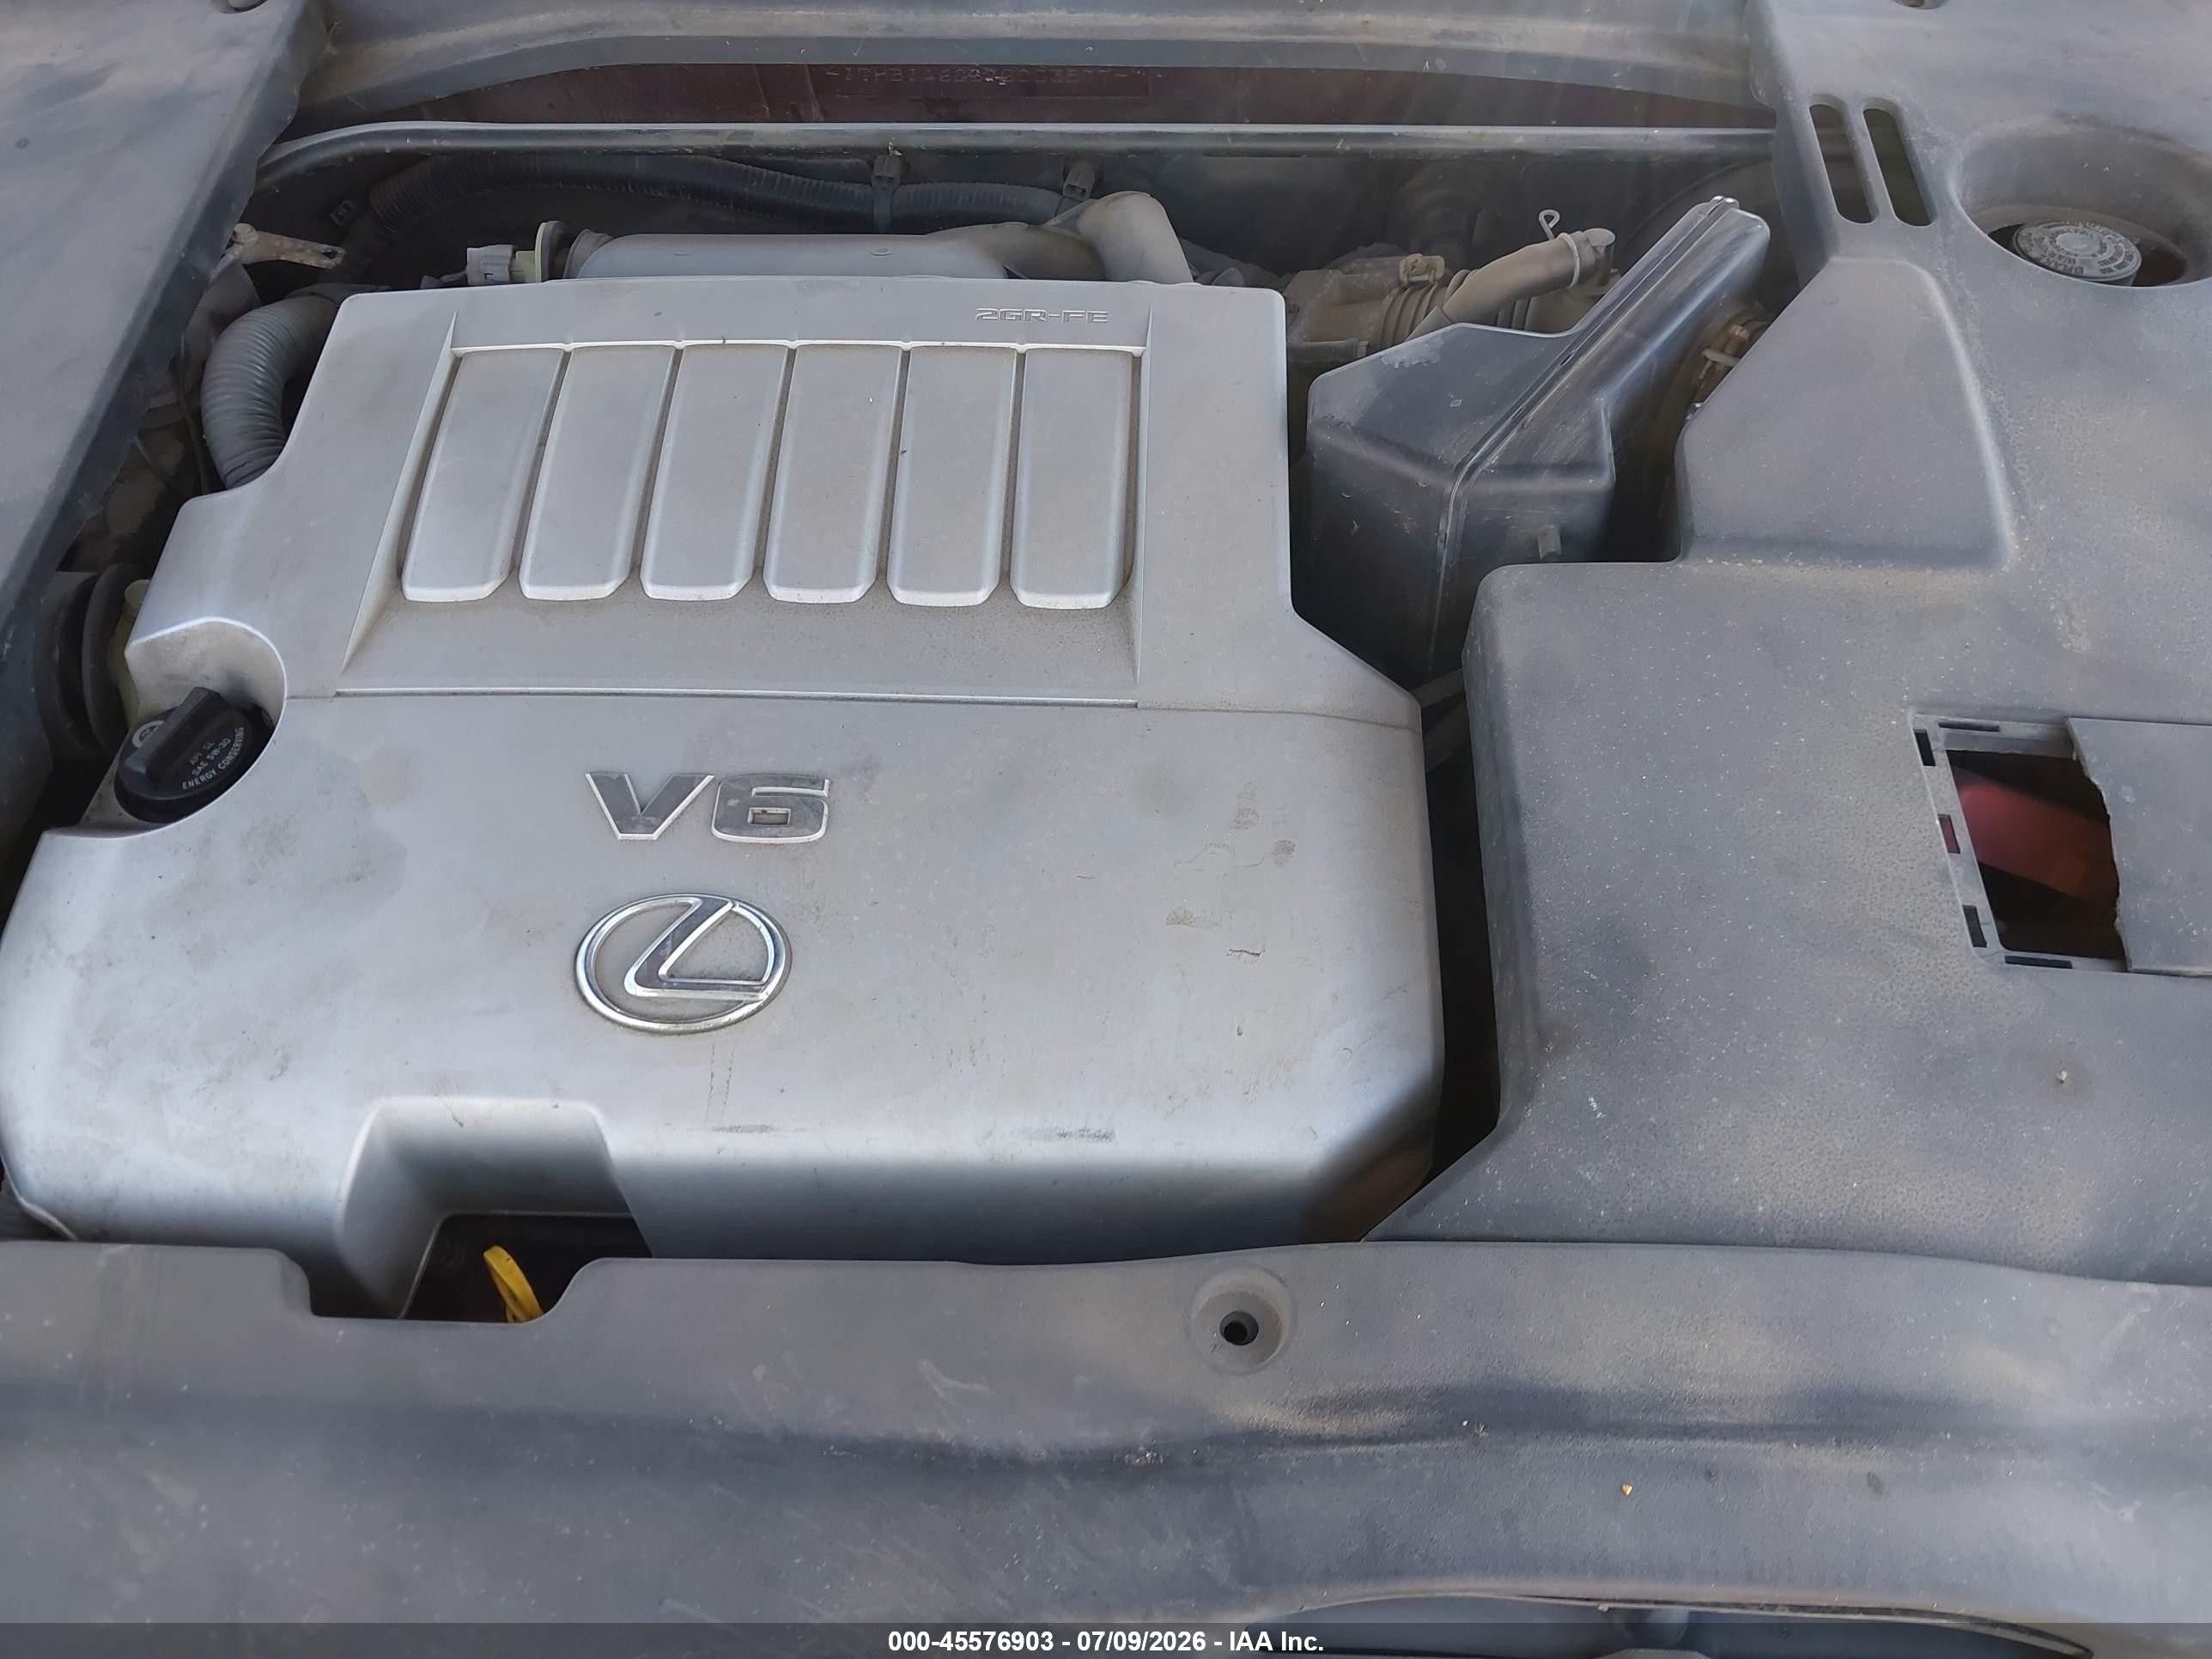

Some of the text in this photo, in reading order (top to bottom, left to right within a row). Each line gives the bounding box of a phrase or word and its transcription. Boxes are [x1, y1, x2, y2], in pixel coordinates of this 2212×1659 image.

[975, 307, 1109, 323] 2GR-FE
[192, 761, 209, 775] SAE
[182, 769, 216, 789] ENERGY
[585, 771, 830, 843] V6
